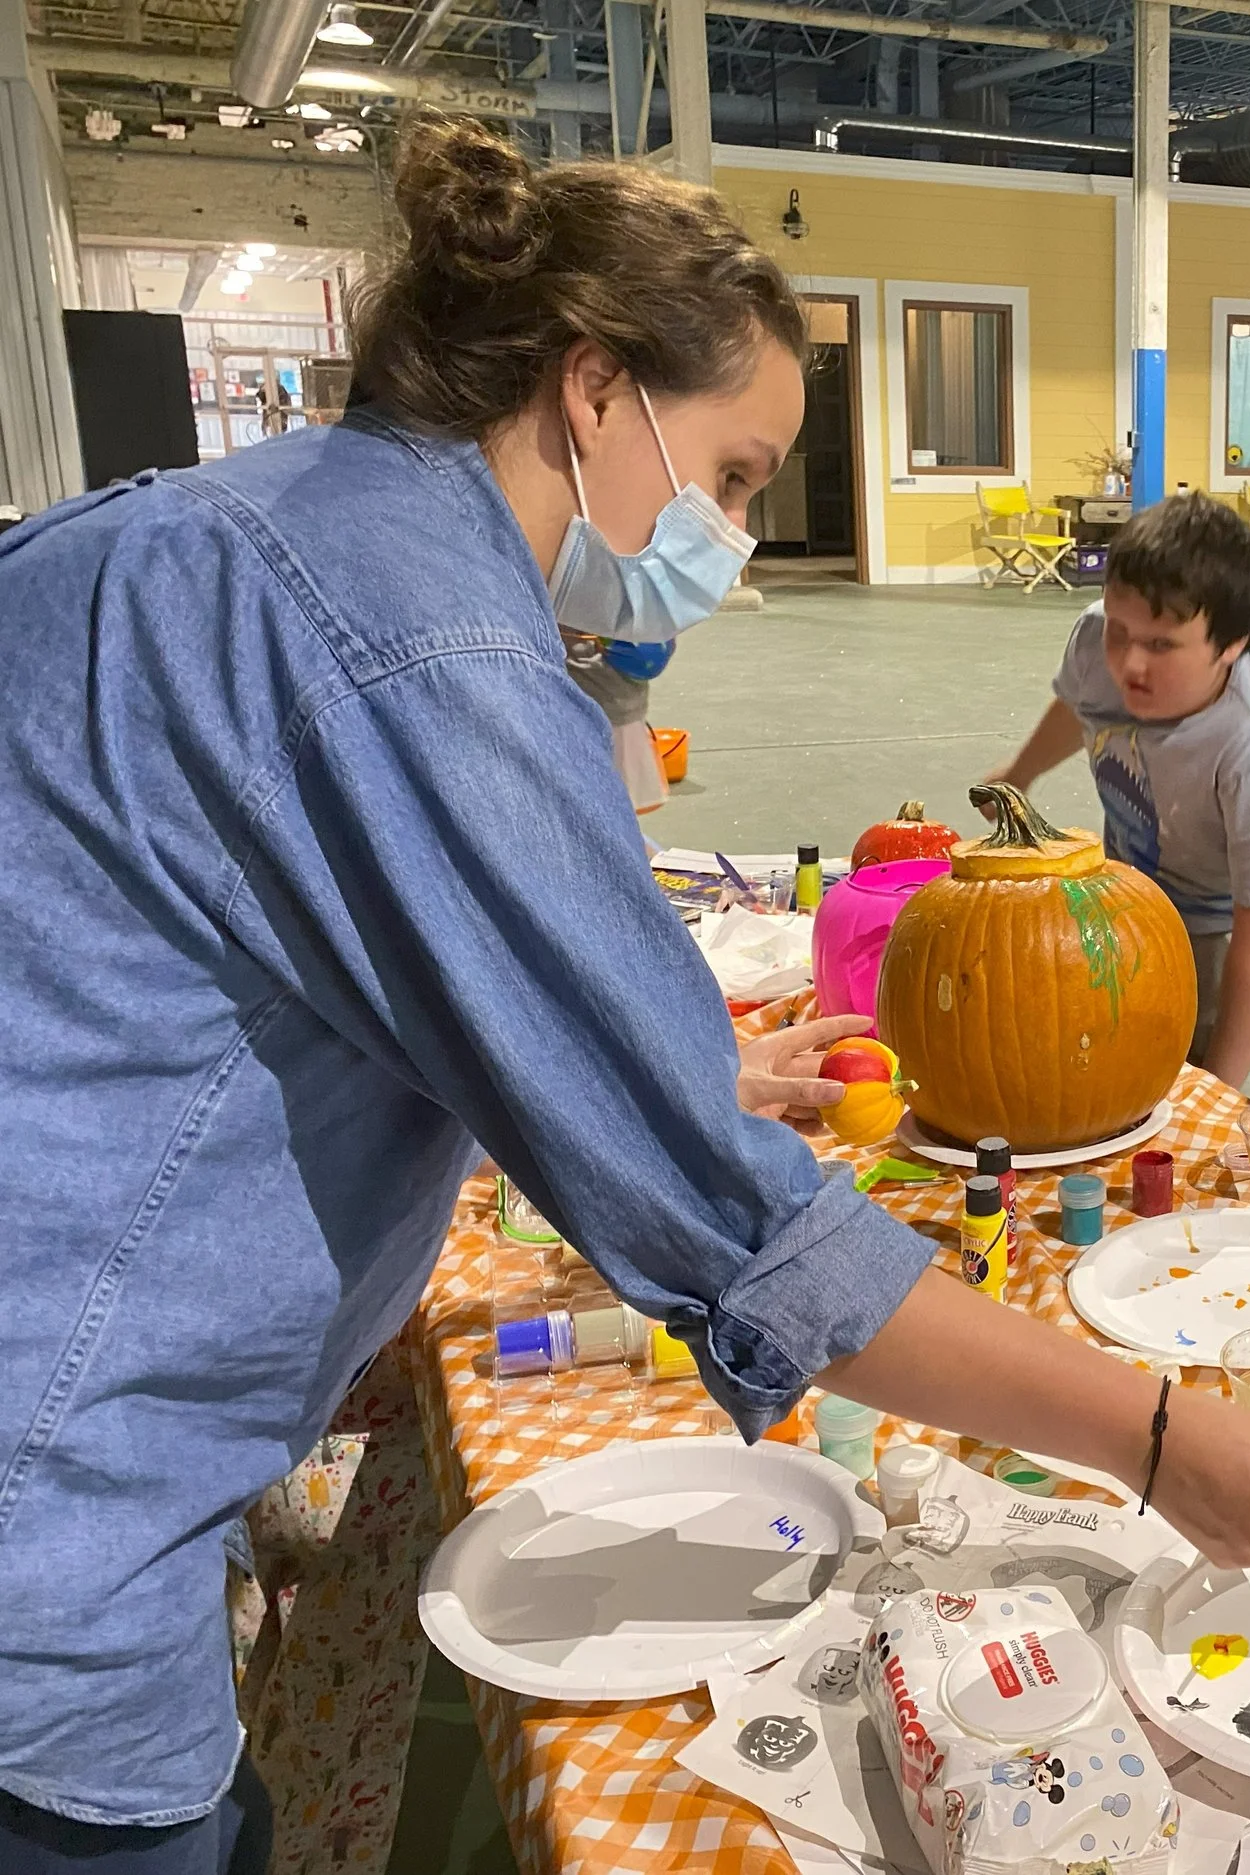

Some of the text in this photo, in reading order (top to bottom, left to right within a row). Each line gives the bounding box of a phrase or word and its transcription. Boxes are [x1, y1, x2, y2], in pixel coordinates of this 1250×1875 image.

[440, 84, 530, 114] STORM
[1007, 1503, 1056, 1525] Happy
[1053, 1508, 1099, 1531] Frank
[920, 1596, 949, 1660] DO NOT FLUSH
[1009, 1639, 1037, 1688] simply clean
[1020, 1631, 1059, 1685] HUGGIES
